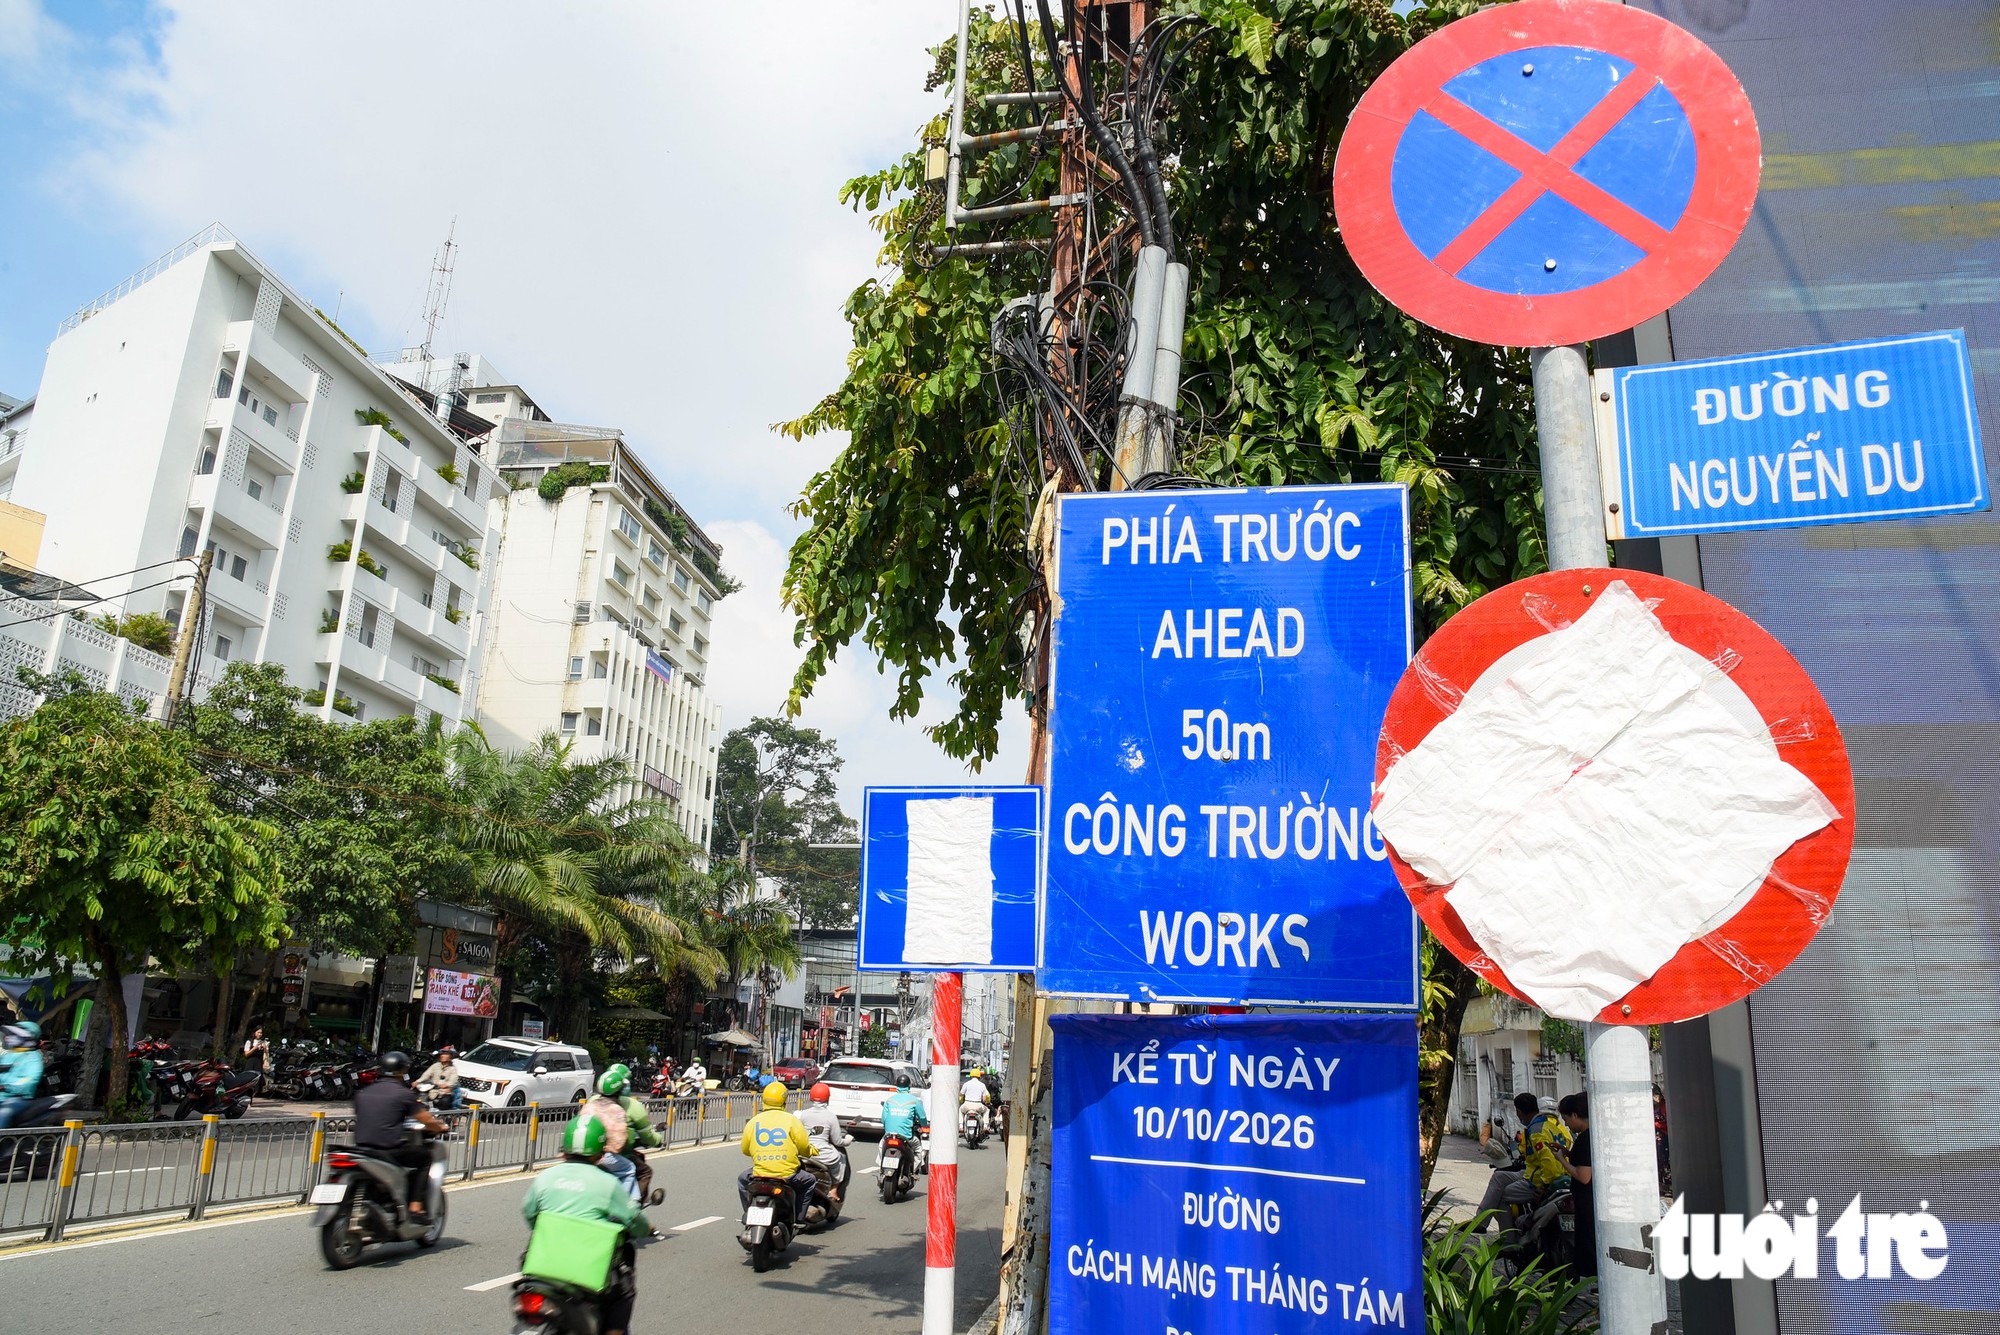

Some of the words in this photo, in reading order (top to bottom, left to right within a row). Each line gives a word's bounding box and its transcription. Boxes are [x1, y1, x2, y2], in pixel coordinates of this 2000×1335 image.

[1691, 368, 1893, 427] ĐƯỜNG
[1668, 431, 1849, 512] NGUYỄN
[1862, 440, 1925, 496] DU
[1102, 504, 1203, 565] PHÍA
[1214, 500, 1362, 563] TRƯỚC
[1152, 608, 1306, 659] AHEAD
[1182, 708, 1271, 761] 50m
[1063, 791, 1187, 858] CÔNG
[1200, 791, 1388, 862] TRƯỜNG
[463, 942, 492, 959] SAIGON
[1139, 910, 1311, 969] WORKS
[1112, 1039, 1160, 1084] KỂ
[1167, 1045, 1217, 1086] TỪ
[1230, 1047, 1340, 1092] NGÀY
[754, 1121, 788, 1147] be
[1133, 1106, 1315, 1150] 10/10/2026
[1182, 1187, 1281, 1235] ĐƯỜNG
[1067, 1238, 1133, 1286] CÁCH
[1141, 1255, 1216, 1301] MẠNG
[1225, 1263, 1328, 1316] THÁNG
[1335, 1277, 1405, 1329] TÁM
